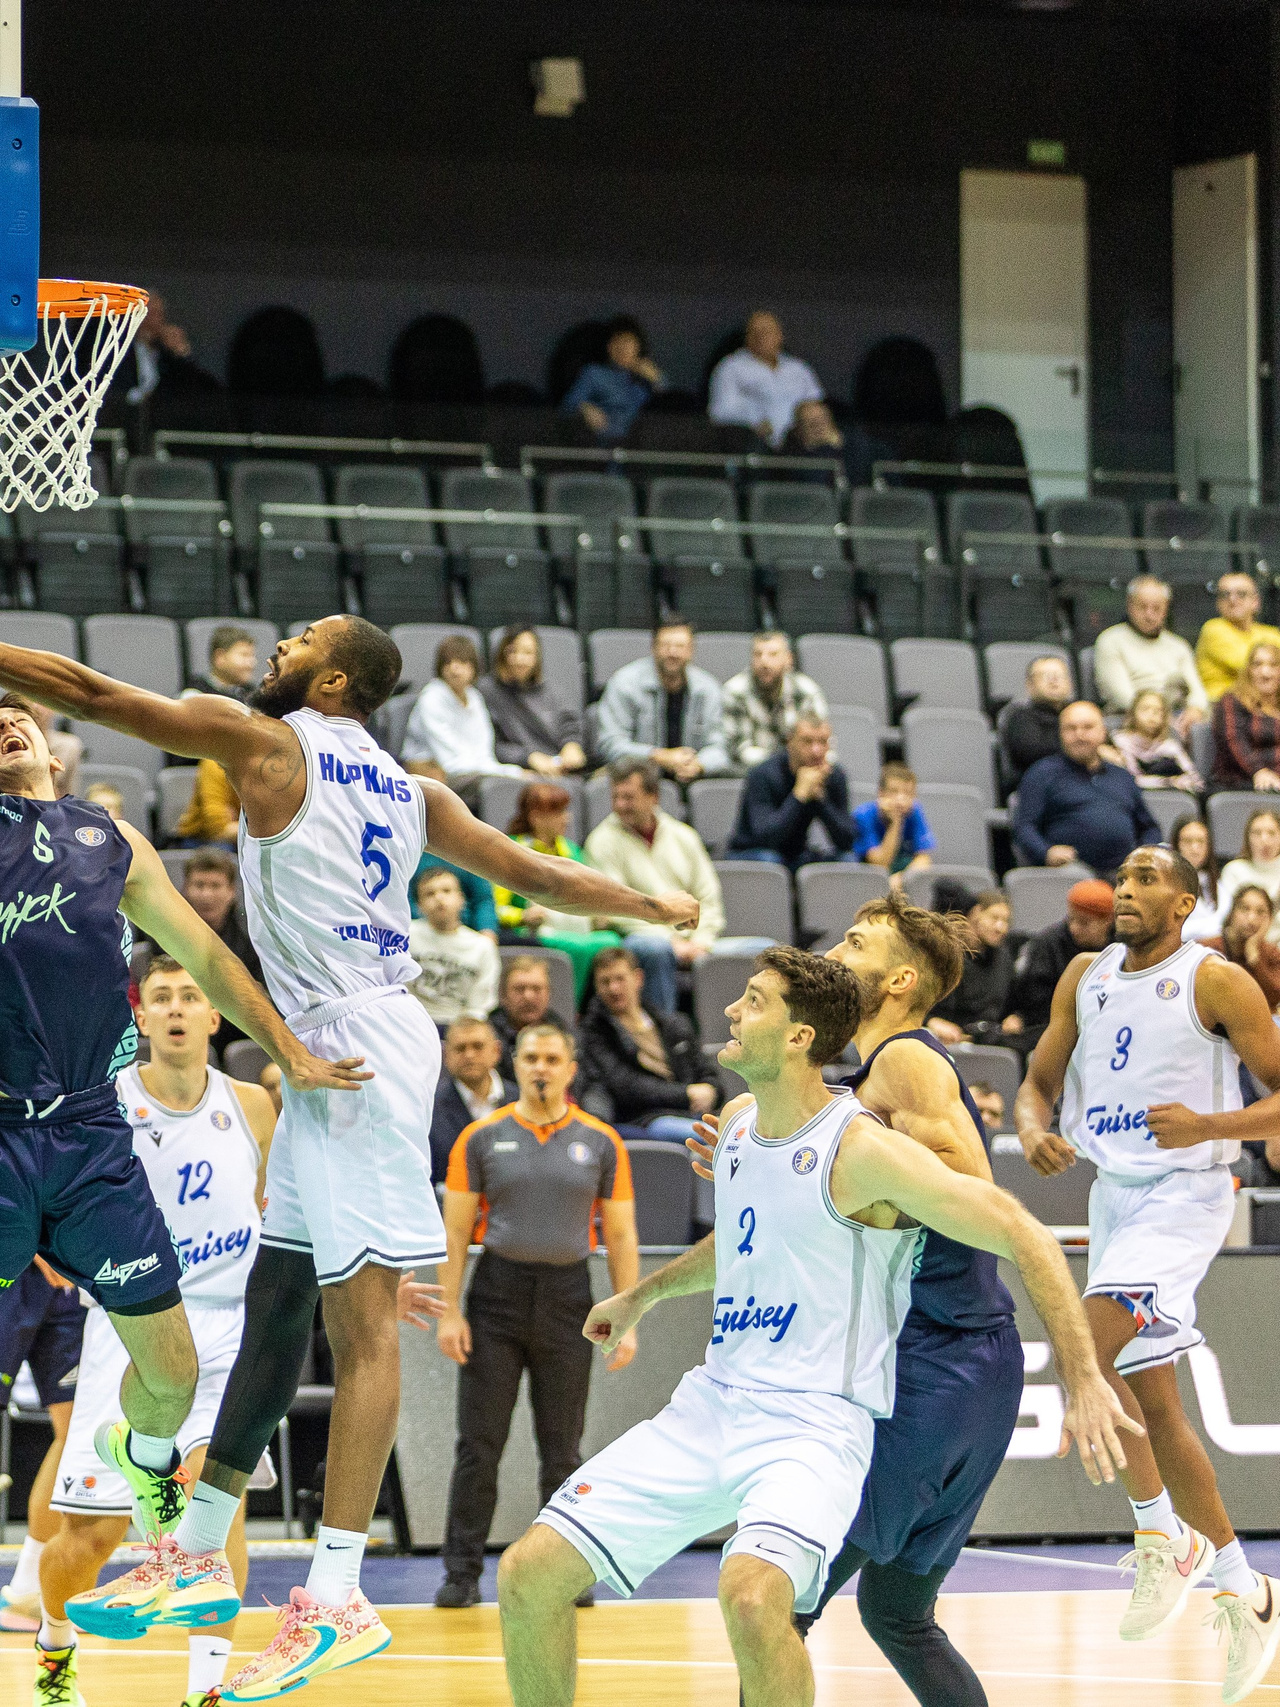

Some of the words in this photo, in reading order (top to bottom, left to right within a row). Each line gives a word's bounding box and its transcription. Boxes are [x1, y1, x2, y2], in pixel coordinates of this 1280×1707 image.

[360, 821, 393, 903] 5
[1110, 1026, 1132, 1071] 3
[177, 1160, 213, 1205] 12
[737, 1207, 756, 1256] 2
[711, 1296, 798, 1344] Enisey
